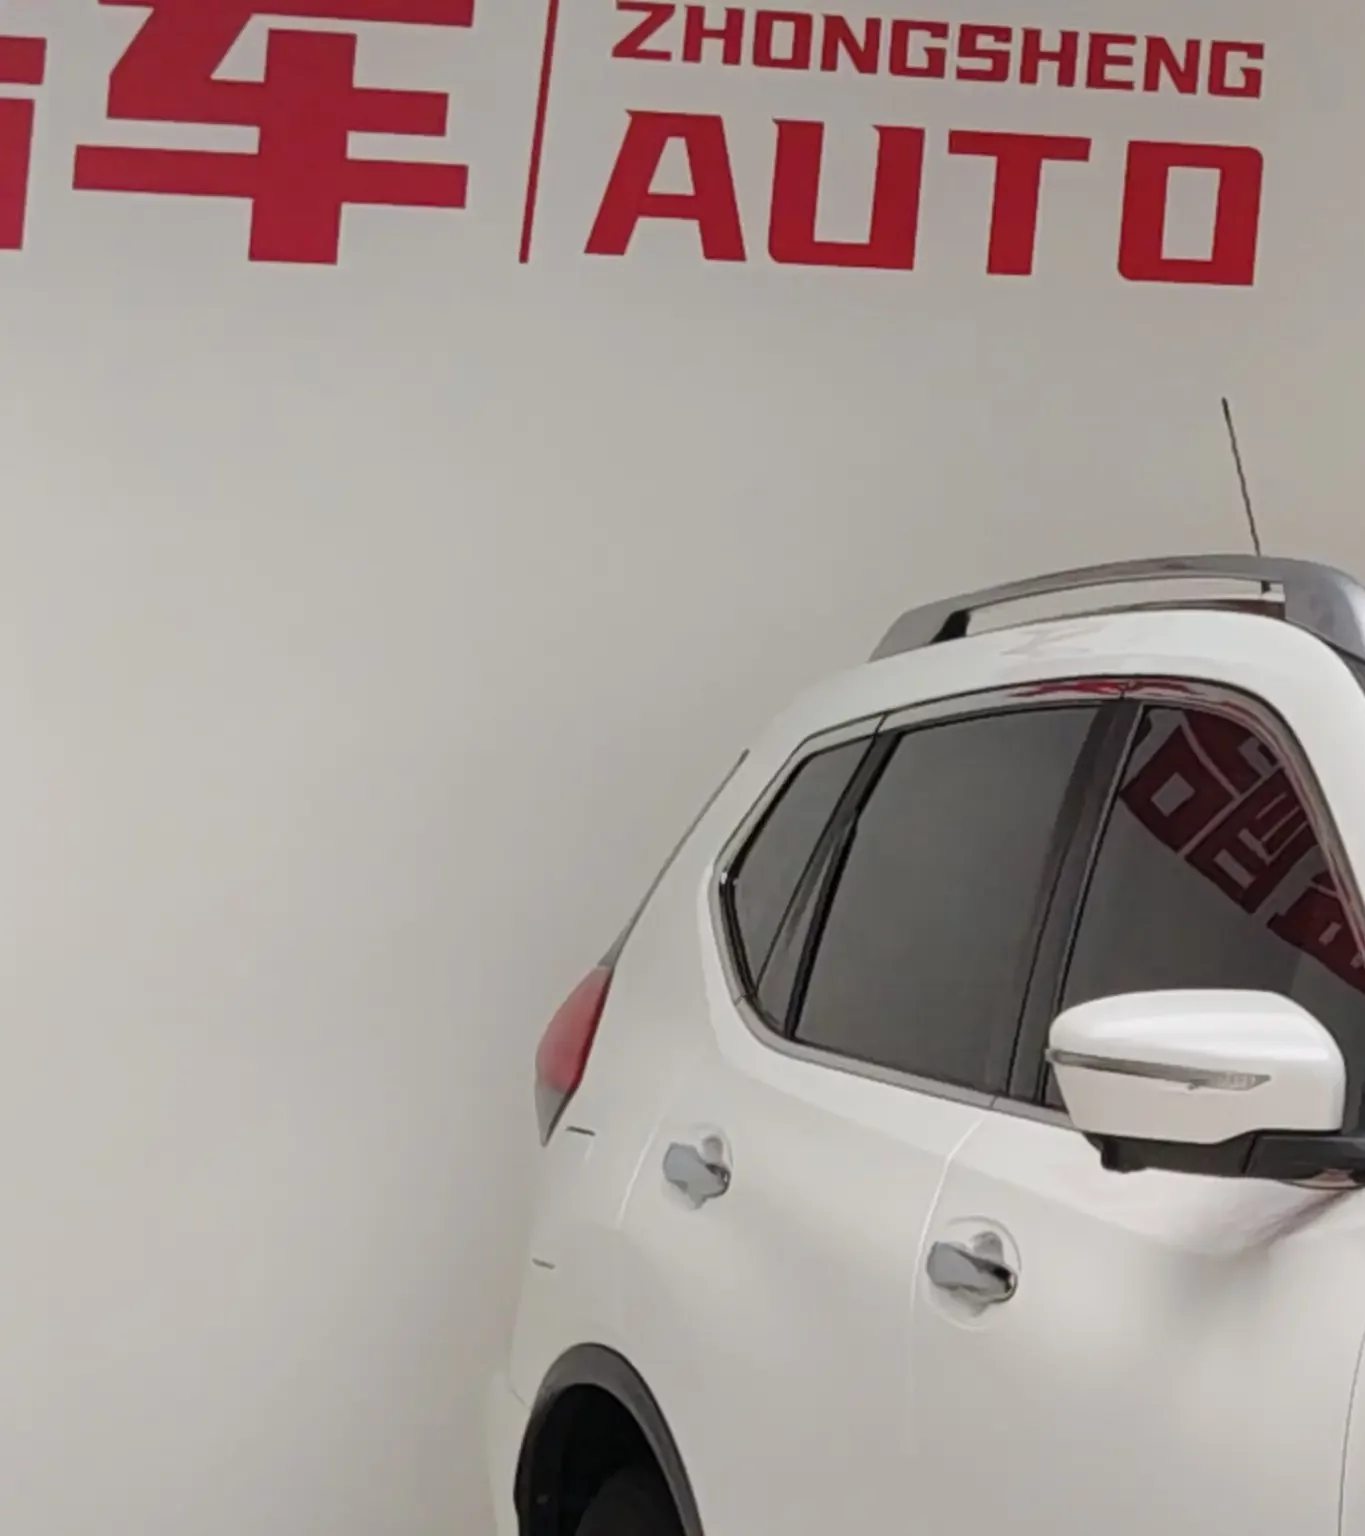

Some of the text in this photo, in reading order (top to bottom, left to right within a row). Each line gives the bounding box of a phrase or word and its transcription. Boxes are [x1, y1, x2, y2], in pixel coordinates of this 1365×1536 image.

[0, 0, 475, 265] 车
[611, 1, 1266, 99] ZHONGSHENG
[583, 108, 1265, 286] AUTO
